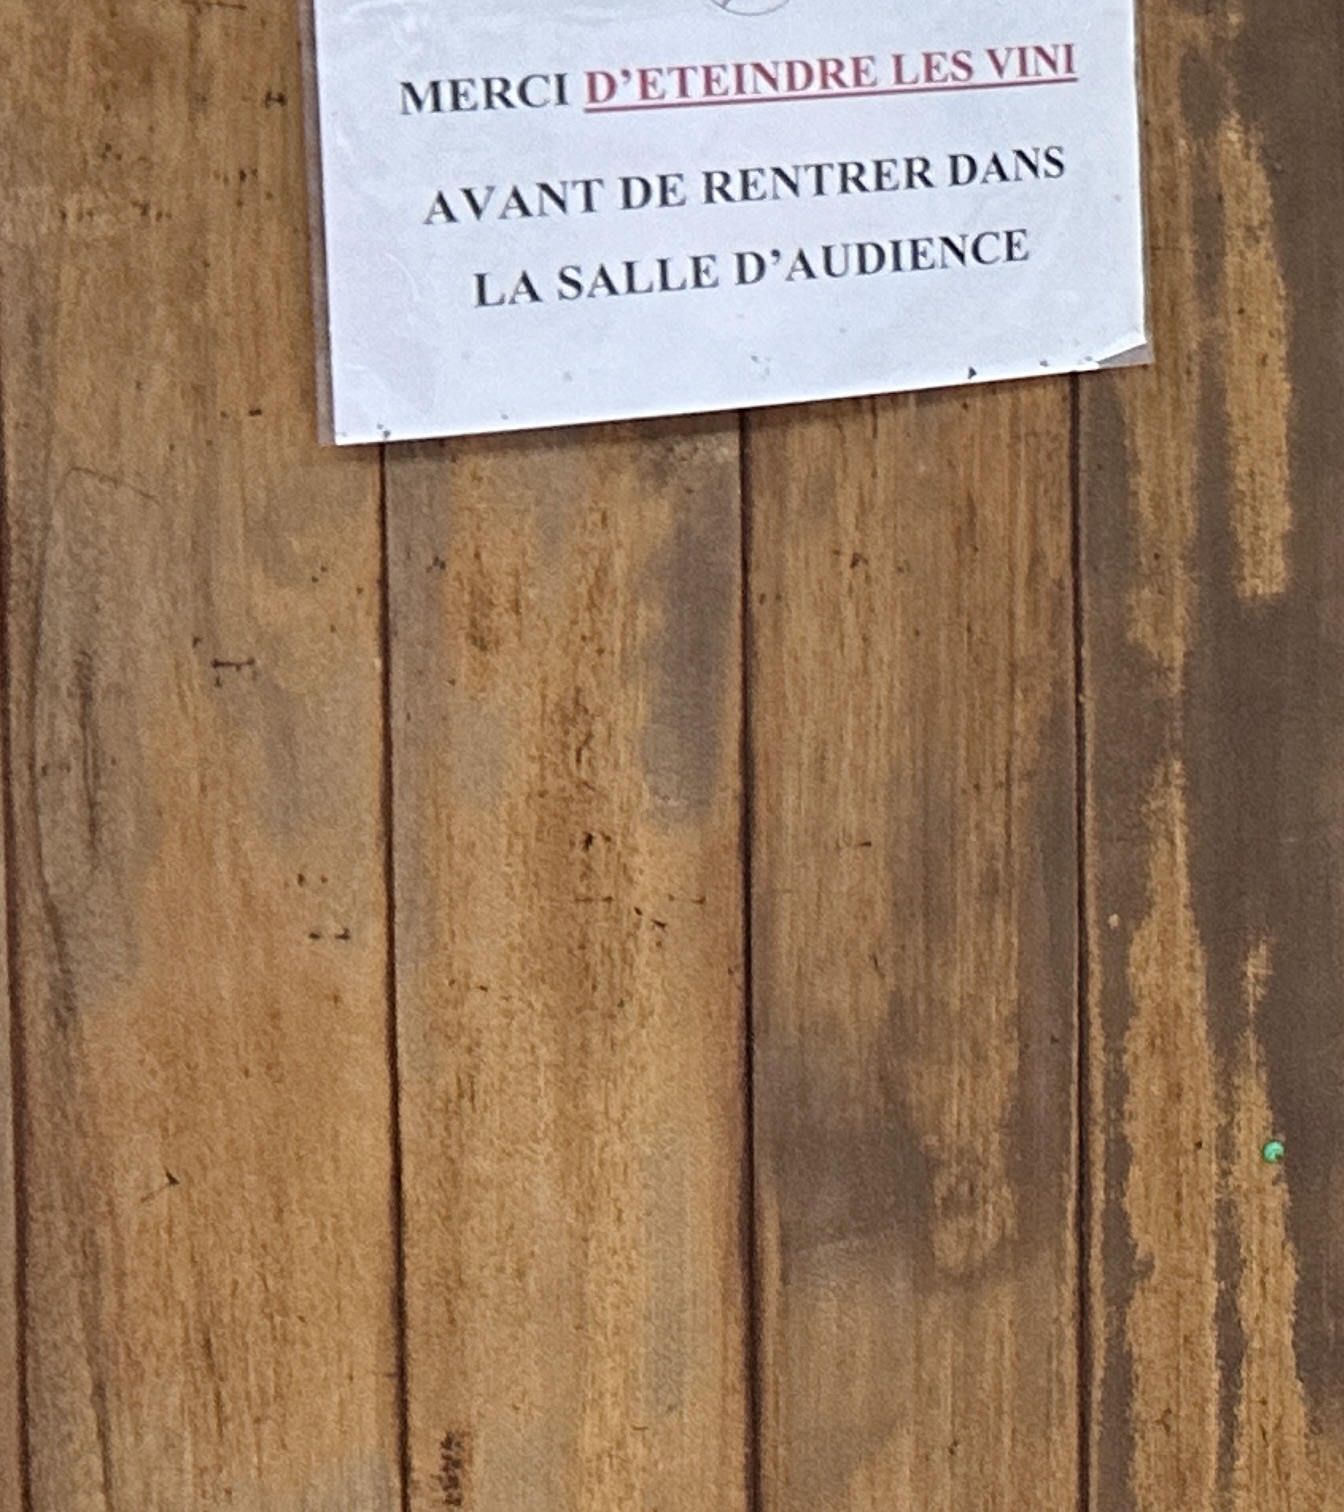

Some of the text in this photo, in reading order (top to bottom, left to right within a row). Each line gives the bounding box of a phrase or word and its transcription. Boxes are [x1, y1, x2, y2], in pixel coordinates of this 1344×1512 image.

[400, 72, 569, 115] MERCI
[891, 50, 973, 85] LES
[986, 43, 1075, 79] VINI
[423, 146, 1064, 224] AVANT DE RENTRER DANS
[473, 270, 543, 308] LA
[557, 254, 719, 301] SALLE
